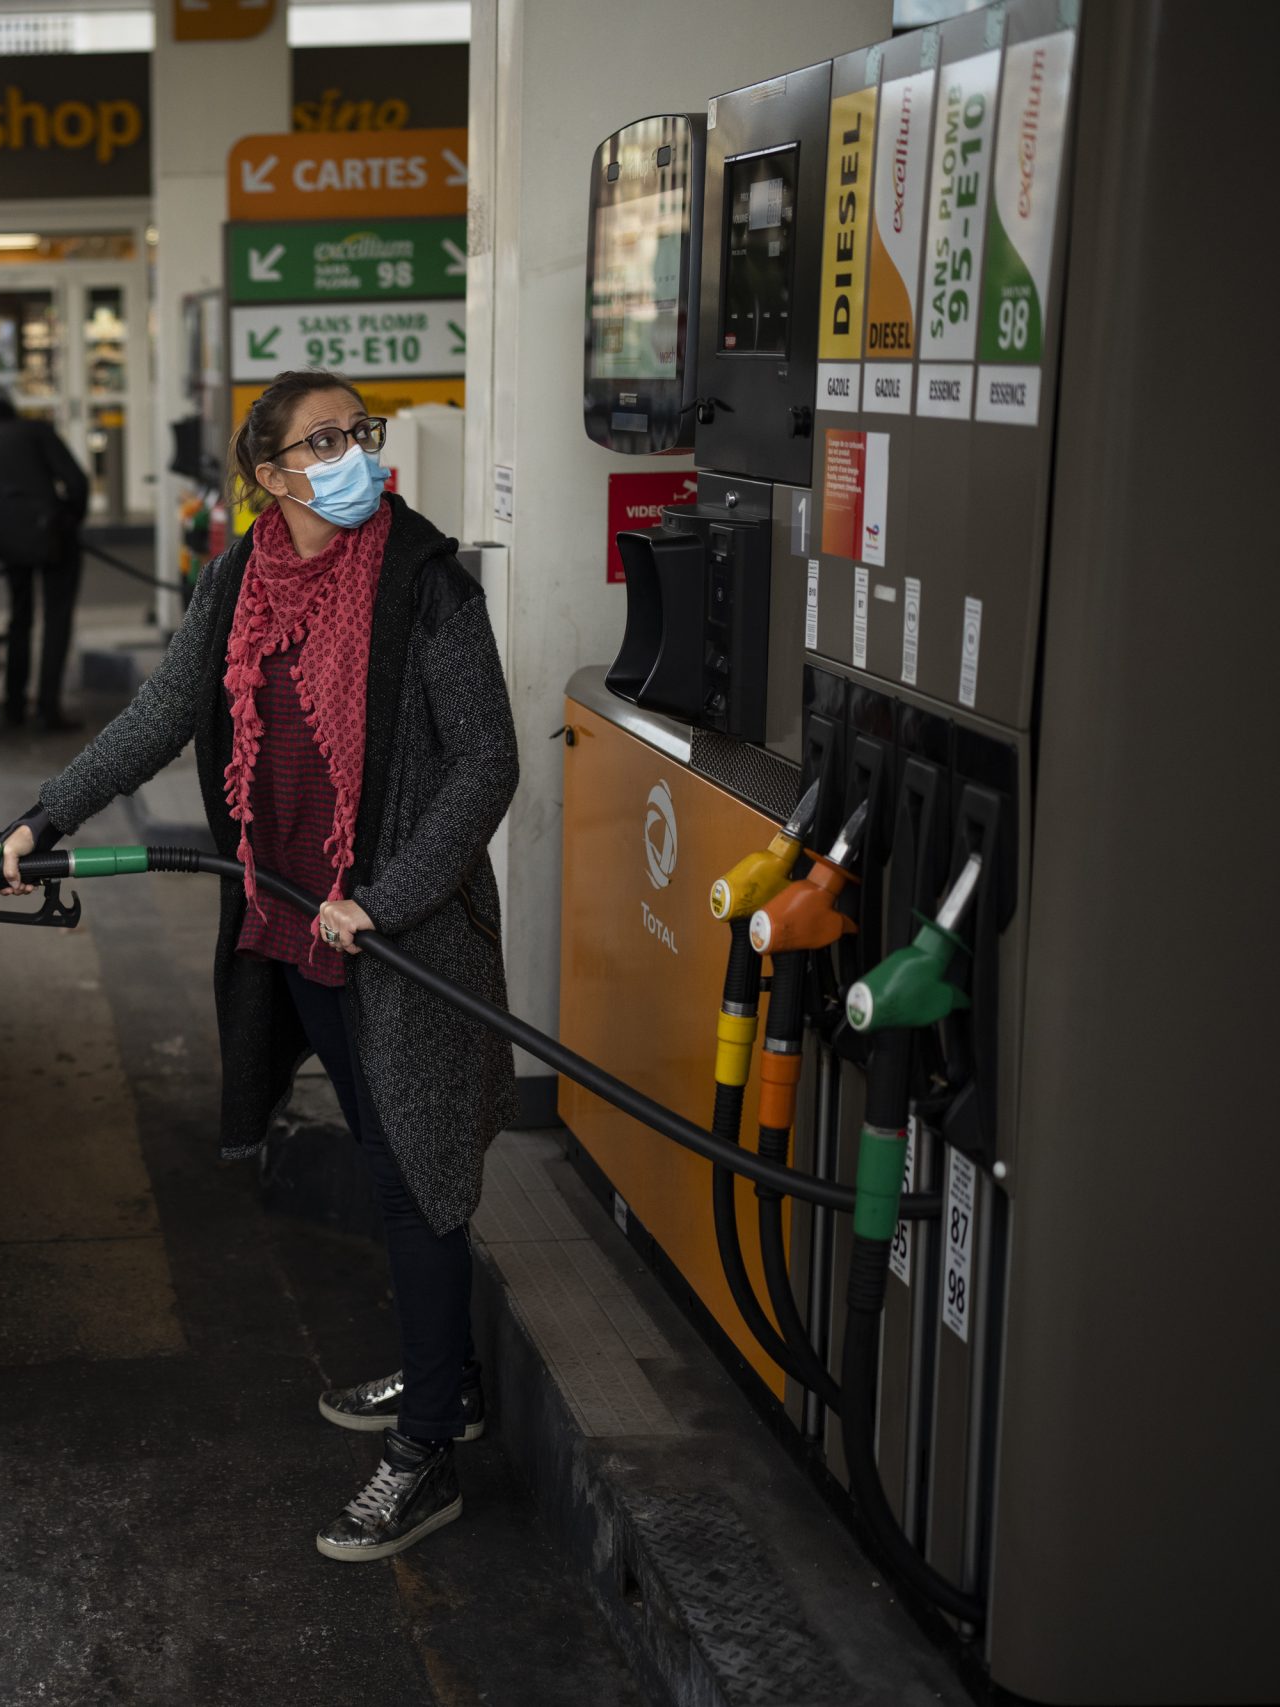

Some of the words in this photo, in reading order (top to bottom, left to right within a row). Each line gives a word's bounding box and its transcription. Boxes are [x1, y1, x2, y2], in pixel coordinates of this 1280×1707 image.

[938, 84, 962, 222] PLOMB
[1018, 48, 1047, 219] excellium
[292, 156, 428, 192] CARTES
[893, 85, 912, 234] excellium
[833, 111, 862, 336] DIESEL
[948, 92, 987, 325] 95-E10
[377, 260, 415, 289] 98
[931, 236, 950, 340] SANS
[298, 316, 352, 335] SANS
[358, 312, 428, 333] PLOMB
[868, 320, 911, 350] DIESEL
[998, 299, 1031, 350] 98
[305, 334, 421, 366] 95-E10
[827, 377, 850, 397] GAZOLE
[875, 378, 901, 399] GAZOLE
[929, 379, 961, 401] ESSENCE
[990, 382, 1027, 407] ESSENCE
[797, 497, 807, 552] 1
[641, 901, 679, 954] TOTAL
[950, 1206, 969, 1249] 87
[947, 1269, 966, 1315] 98
